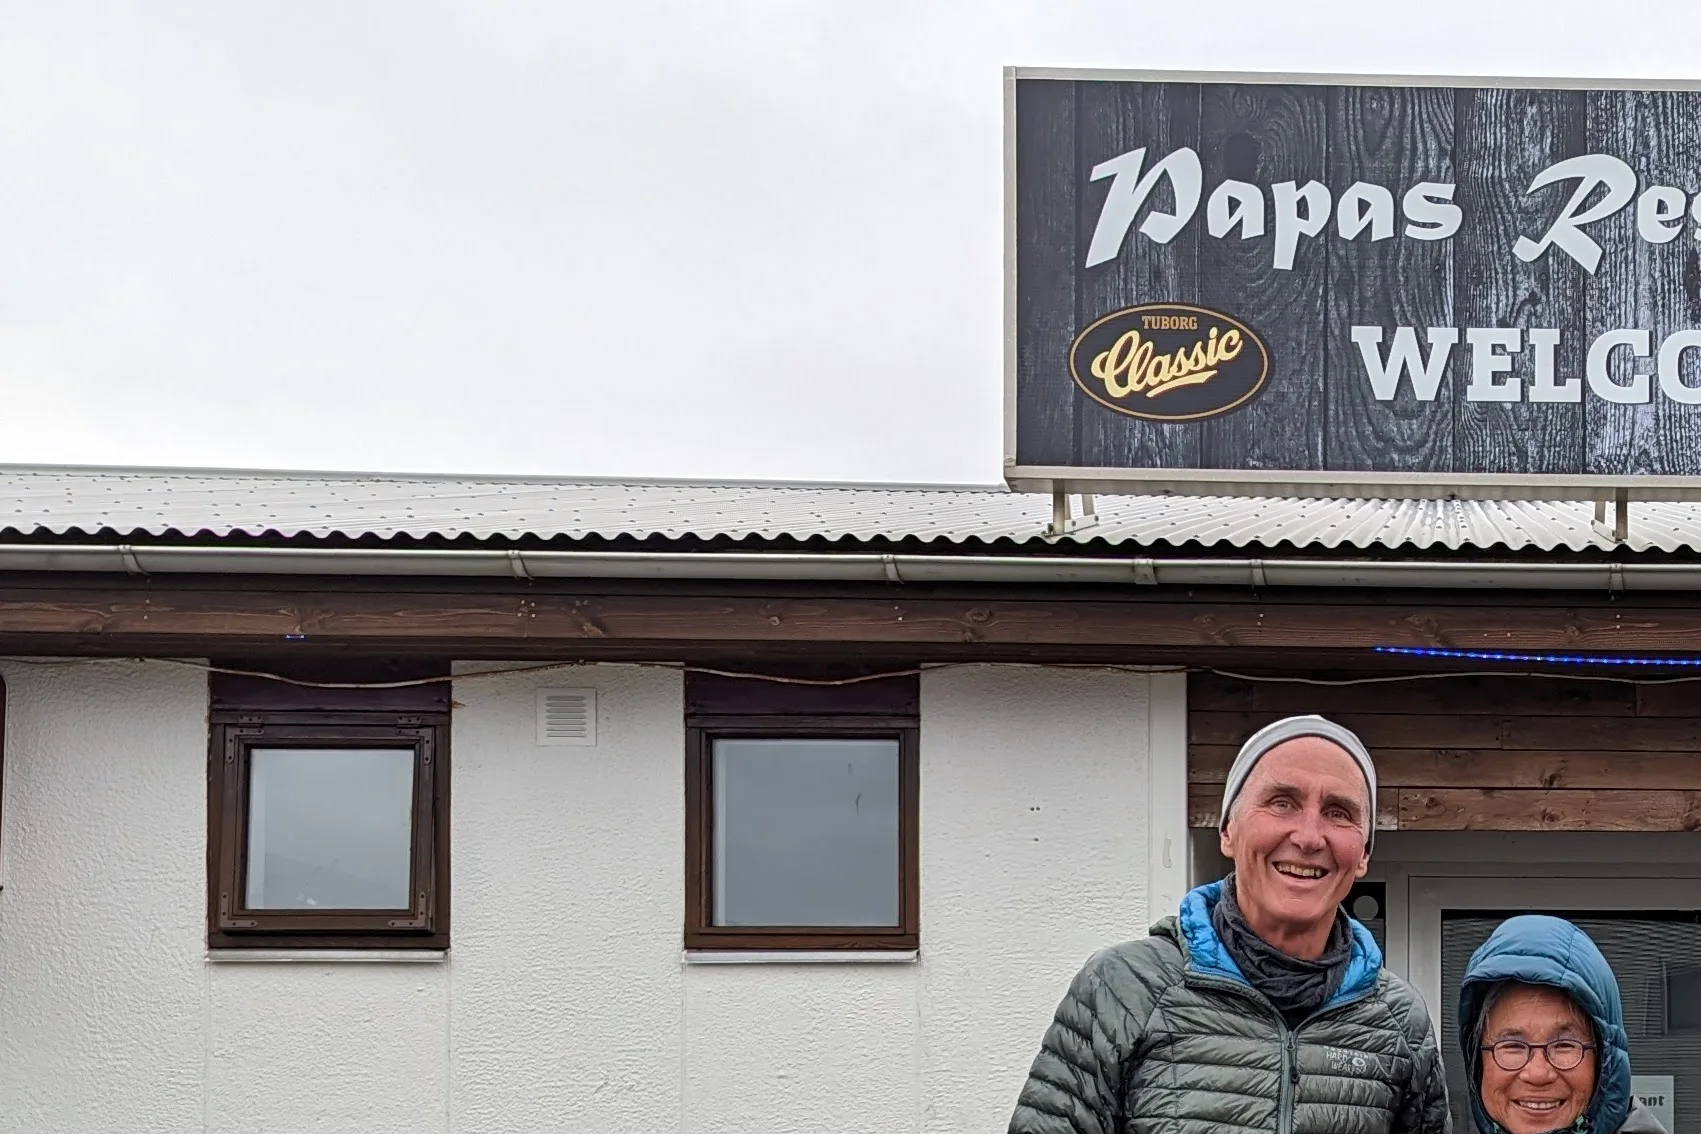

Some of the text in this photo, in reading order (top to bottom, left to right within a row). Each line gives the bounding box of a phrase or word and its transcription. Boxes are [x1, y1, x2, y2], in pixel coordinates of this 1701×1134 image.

[1085, 147, 1463, 270] Papas
[1142, 316, 1198, 330] TUBORG
[1091, 327, 1243, 398] Classic
